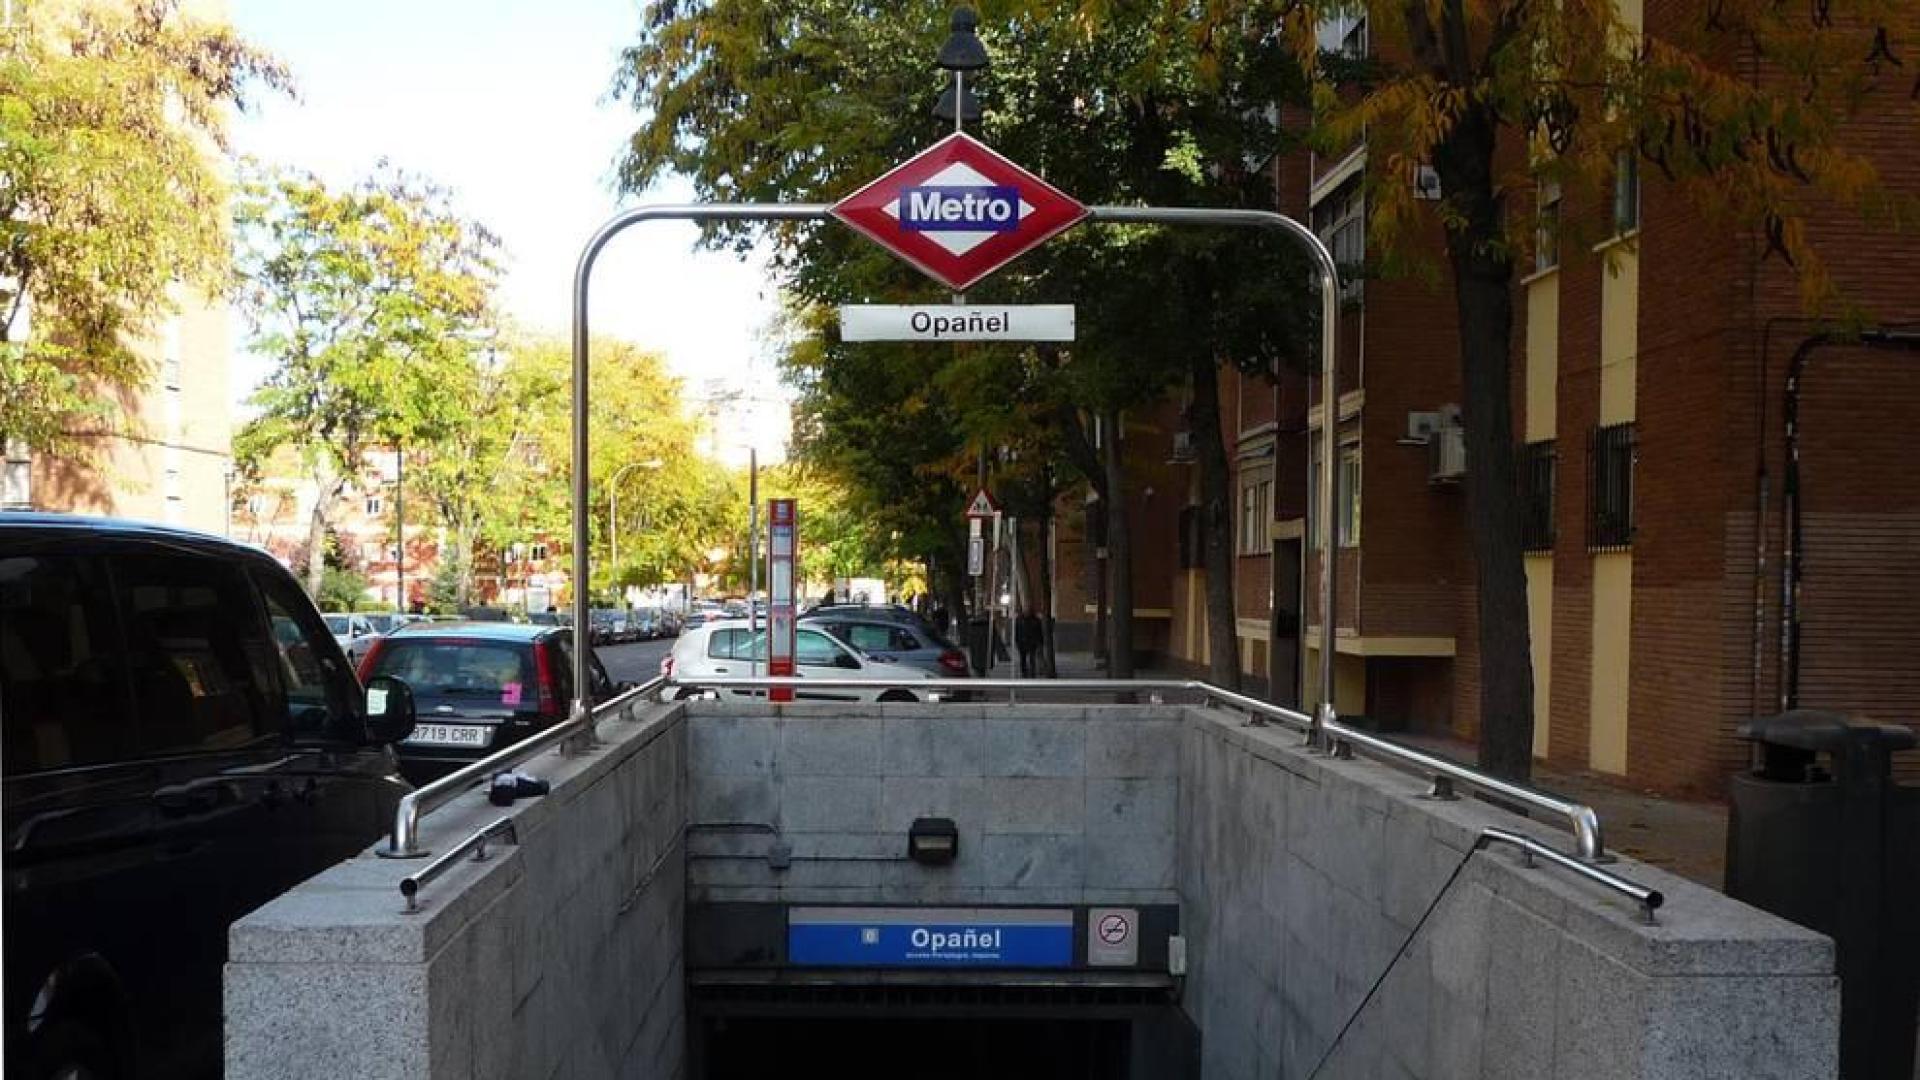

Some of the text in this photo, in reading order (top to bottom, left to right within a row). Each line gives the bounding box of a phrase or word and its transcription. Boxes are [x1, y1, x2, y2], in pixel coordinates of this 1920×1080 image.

[910, 192, 1010, 221] Metro
[911, 311, 1009, 336] Opañel
[911, 928, 1000, 953] Opañel
